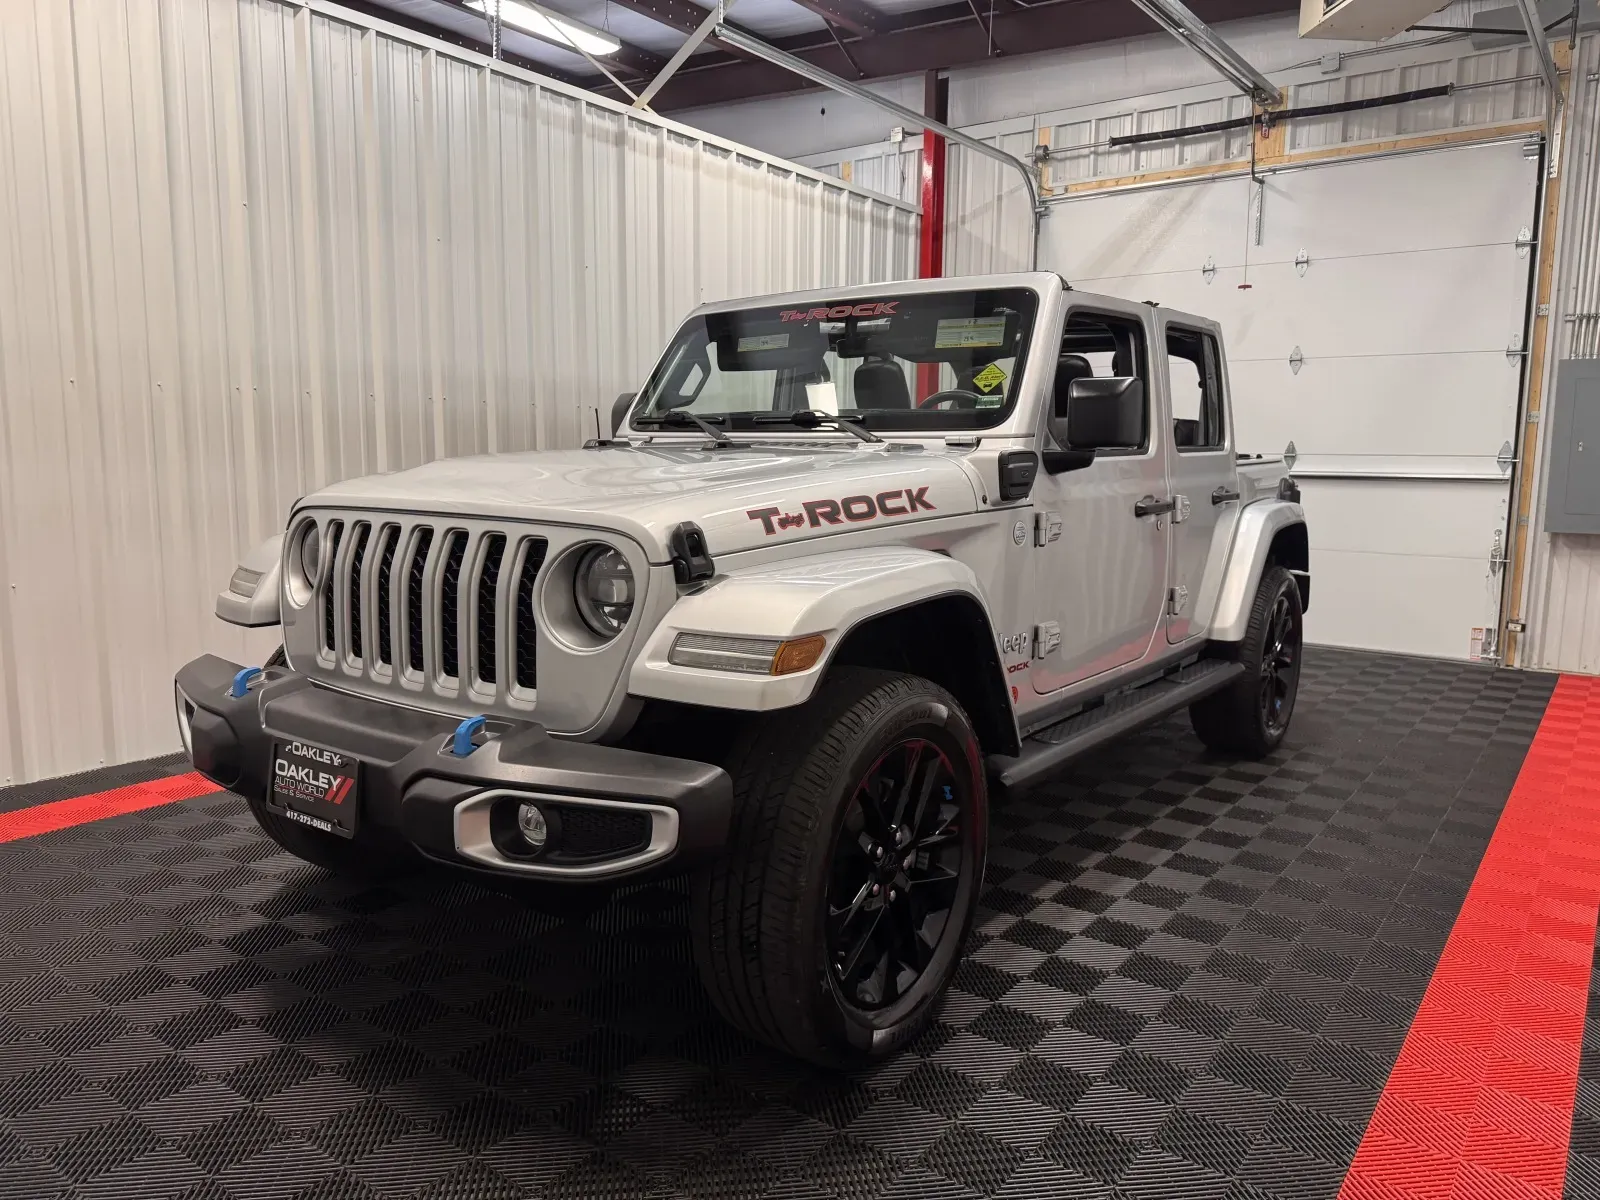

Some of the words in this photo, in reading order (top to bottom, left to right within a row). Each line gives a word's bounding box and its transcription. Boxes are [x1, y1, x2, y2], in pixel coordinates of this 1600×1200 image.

[1006, 660, 1030, 674] OCK
[292, 741, 342, 766] OAKLEY
[274, 775, 296, 789] AUTO
[296, 781, 325, 799] WORLD
[275, 758, 342, 792] OAKLEY
[286, 810, 332, 832] 417-272-DEALS
